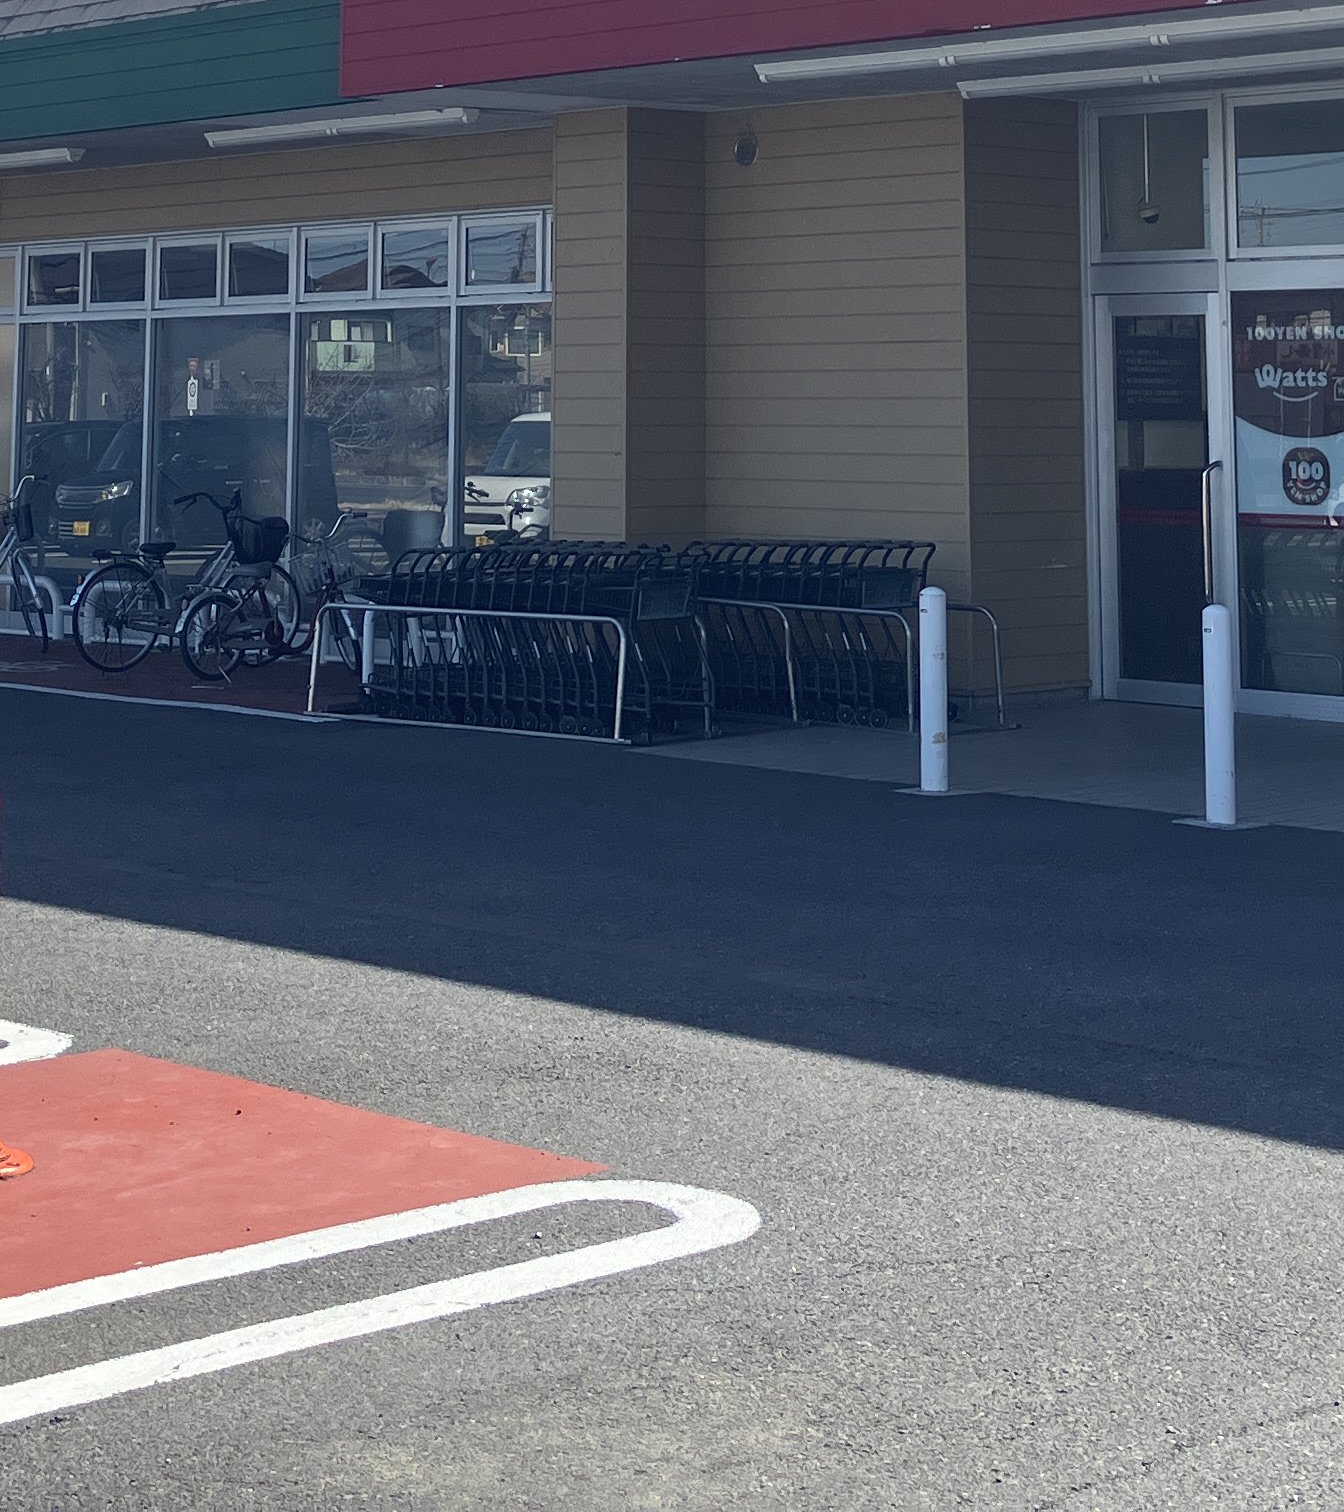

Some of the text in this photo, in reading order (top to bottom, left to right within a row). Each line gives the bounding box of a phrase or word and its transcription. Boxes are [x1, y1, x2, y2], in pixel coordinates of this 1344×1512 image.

[1246, 326, 1307, 341] 100YEN
[1254, 363, 1328, 388] Watts
[1288, 461, 1324, 480] 100
